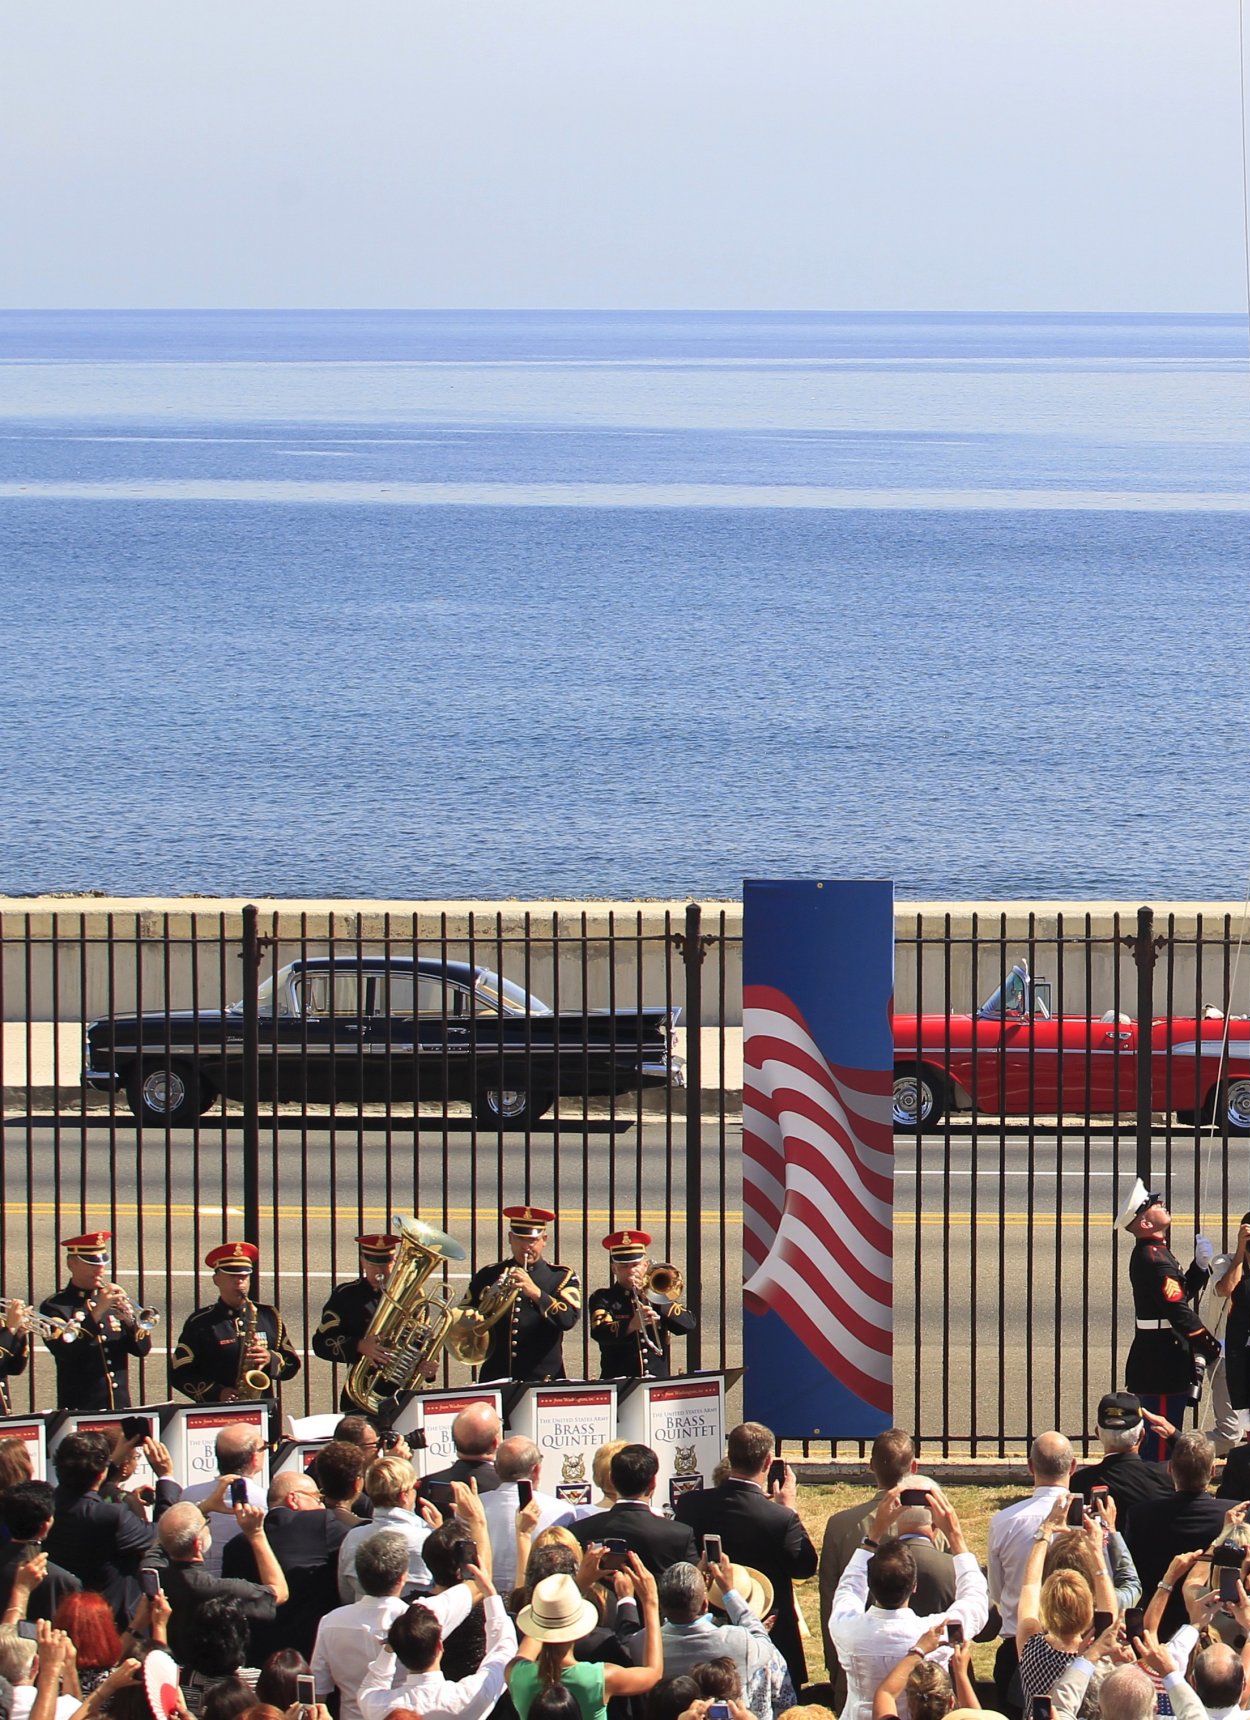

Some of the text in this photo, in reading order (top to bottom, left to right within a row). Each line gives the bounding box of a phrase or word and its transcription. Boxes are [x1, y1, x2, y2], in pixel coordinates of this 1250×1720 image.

[664, 1409, 685, 1417] UNITED
[666, 1415, 705, 1429] BRASS
[554, 1423, 595, 1436] BRASS
[655, 1425, 717, 1442] QUINTET
[542, 1434, 607, 1450] QUINTET
